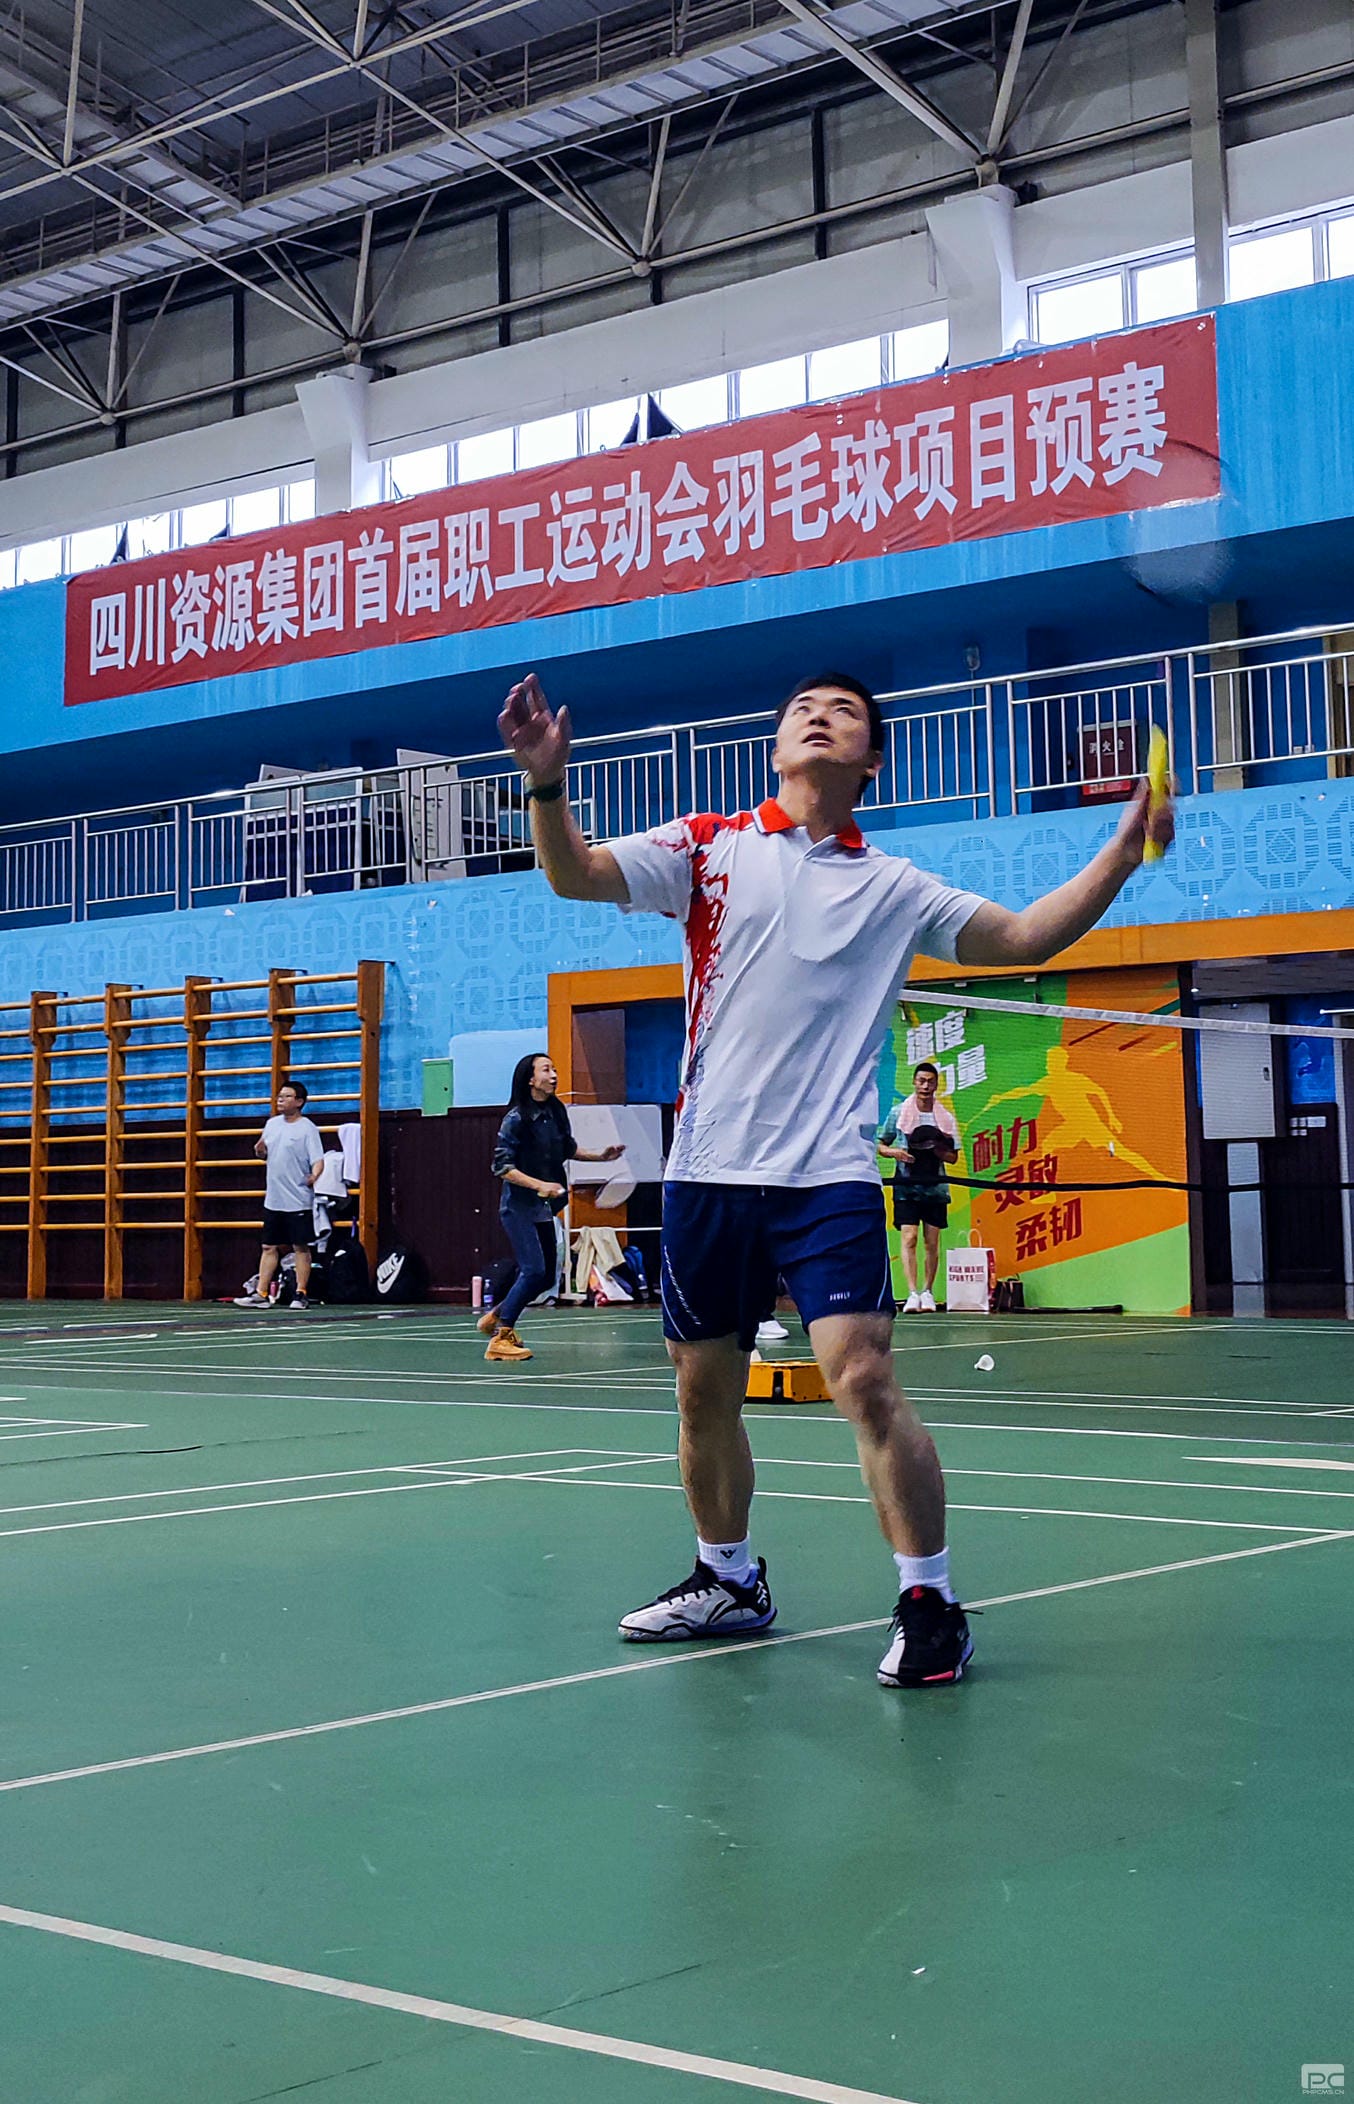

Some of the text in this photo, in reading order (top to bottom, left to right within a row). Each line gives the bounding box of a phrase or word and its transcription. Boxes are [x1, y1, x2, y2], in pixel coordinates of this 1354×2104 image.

[89, 361, 1168, 676] 四川资源集团首届职工运动会羽毛球项目预赛
[972, 1117, 1038, 1173] 耐力
[994, 1153, 1058, 1213] 灵敏
[1016, 1197, 1082, 1261] 柔韧
